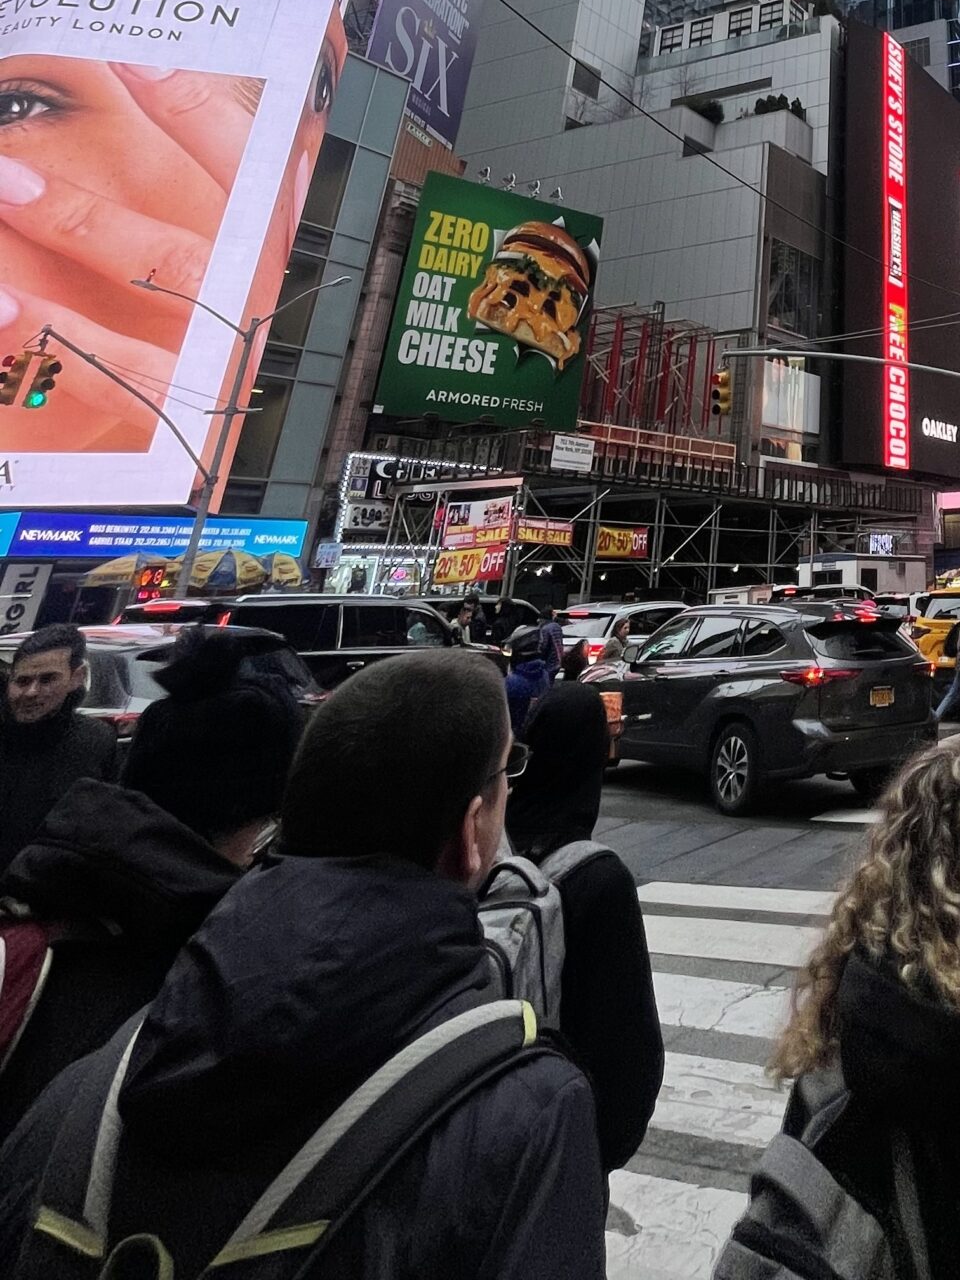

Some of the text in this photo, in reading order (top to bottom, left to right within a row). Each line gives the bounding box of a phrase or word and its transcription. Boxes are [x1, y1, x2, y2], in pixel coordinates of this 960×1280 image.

[0, 16, 182, 42] EAUTY LONDON
[384, 6, 460, 117] SIX
[887, 114, 904, 187] STORE
[424, 211, 490, 253] ZERO
[418, 244, 484, 279] DAIRY
[412, 271, 457, 302] OAT
[405, 300, 462, 333] MILK
[397, 329, 499, 375] CHEESE
[922, 417, 958, 443] OAKLEY
[20, 530, 83, 542] NEWMARK
[253, 534, 300, 545] NEWMARK
[475, 527, 511, 543] SALE
[518, 527, 572, 544] SALE SALE
[632, 533, 648, 551] OFF
[480, 551, 506, 573] OFF
